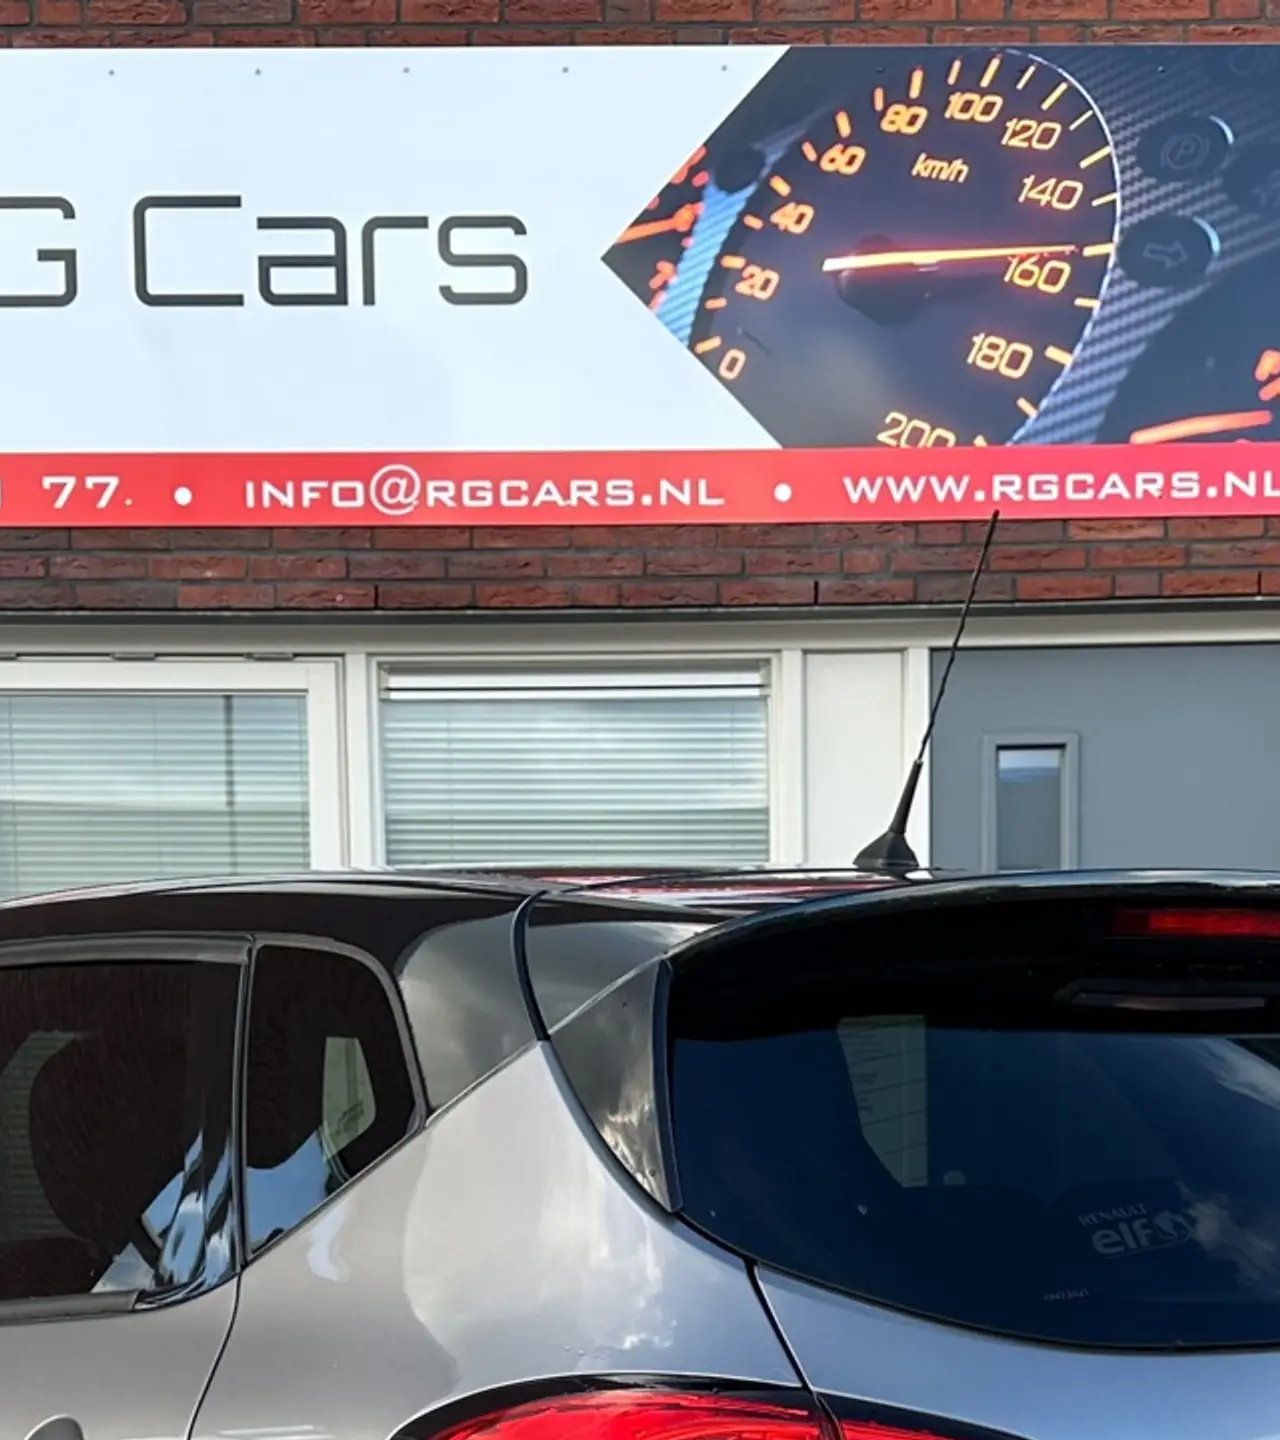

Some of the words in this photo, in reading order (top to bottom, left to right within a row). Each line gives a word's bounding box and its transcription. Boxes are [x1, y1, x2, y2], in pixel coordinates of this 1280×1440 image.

[880, 104, 928, 135] 80
[944, 92, 1003, 122] 100
[1001, 118, 1061, 150] 120
[820, 143, 866, 175] 60
[912, 153, 969, 183] km/h
[1018, 175, 1083, 210] 140
[770, 201, 815, 235] 40
[133, 195, 527, 307] Cars
[734, 265, 780, 300] 20
[1004, 254, 1071, 294] 160
[718, 348, 747, 381] 0
[966, 332, 1034, 380] 180
[245, 464, 726, 516] INFO@RGCARS.NL
[1076, 1202, 1148, 1228] RENAULT
[1092, 1218, 1154, 1255] elf
